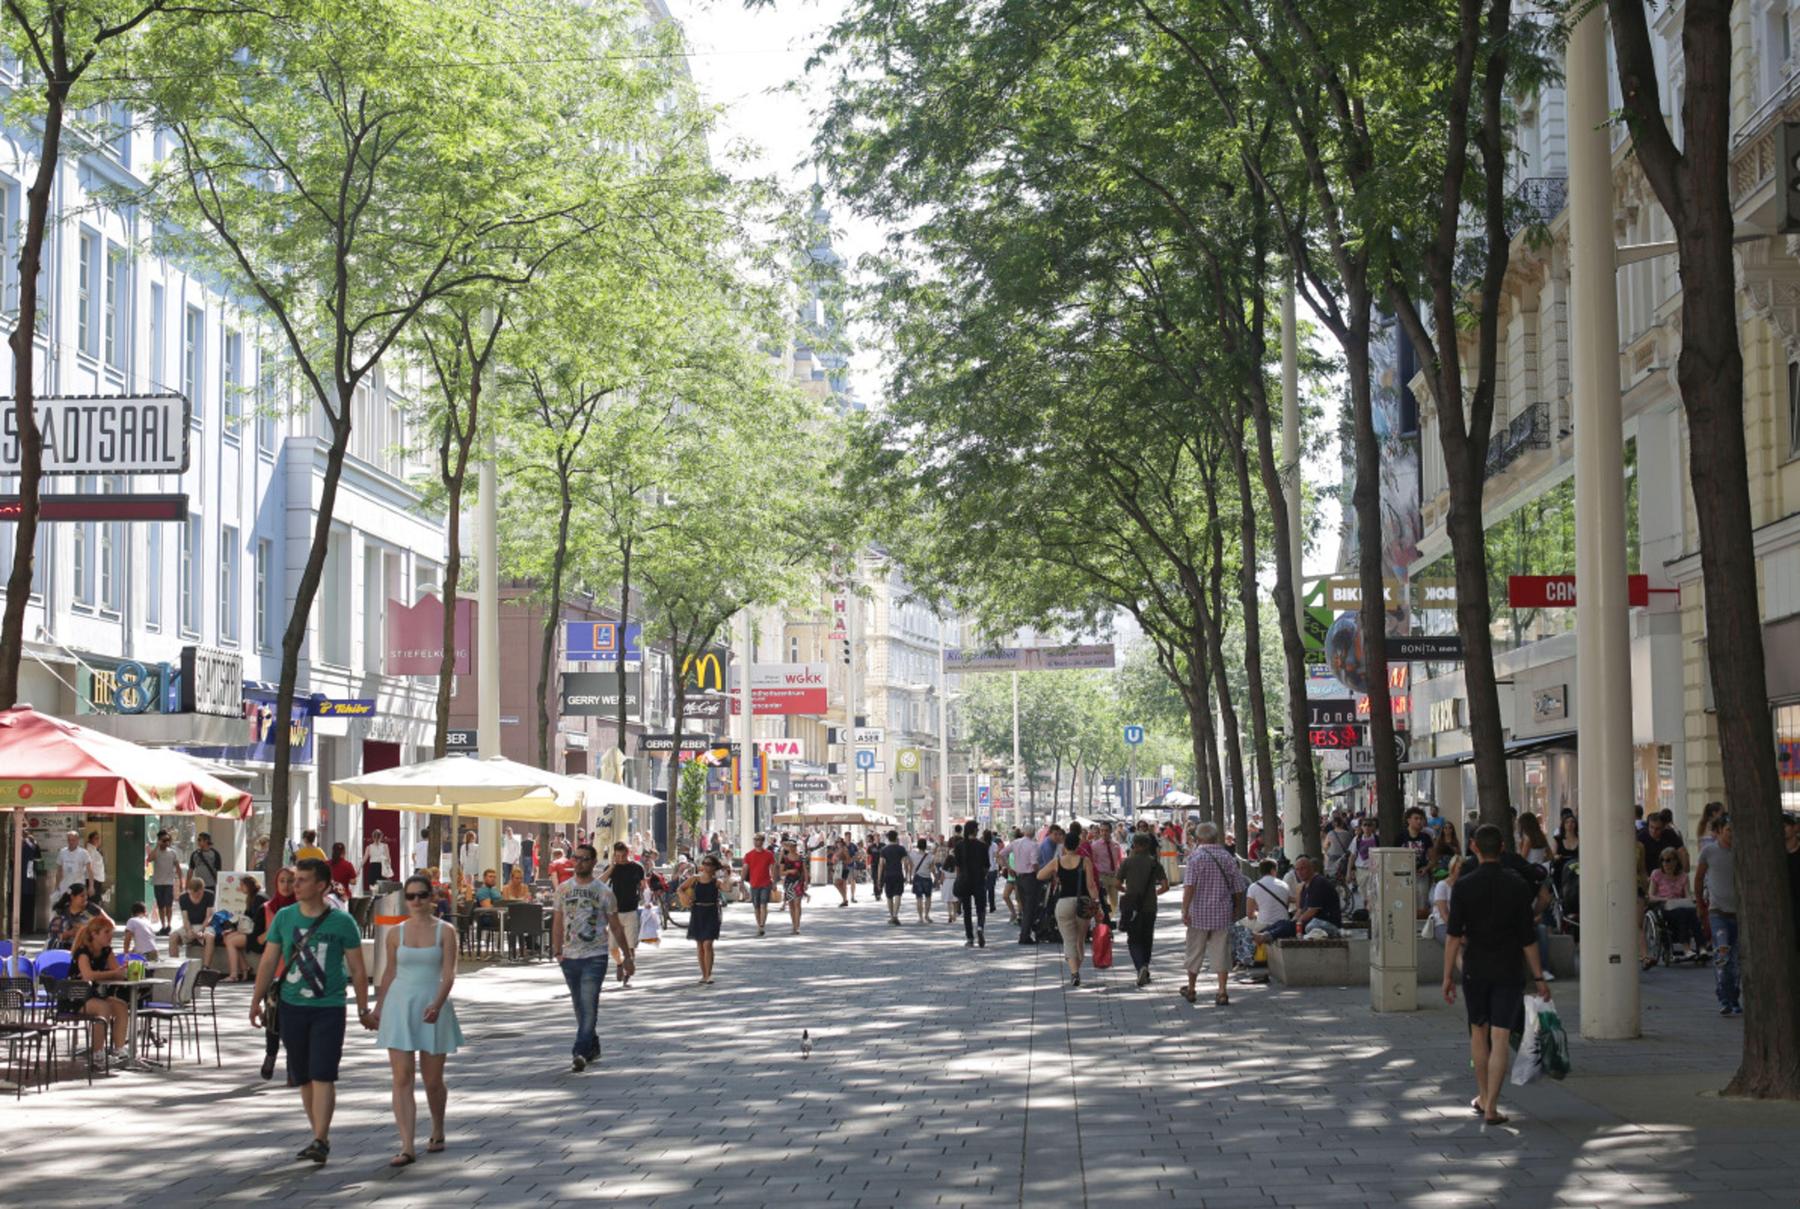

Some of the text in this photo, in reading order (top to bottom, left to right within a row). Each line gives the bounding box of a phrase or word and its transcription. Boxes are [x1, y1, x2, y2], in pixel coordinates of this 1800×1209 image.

[4, 405, 176, 463] SADTSAAL
[389, 648, 467, 658] STIEFELKIG
[568, 695, 636, 705] GERRY WEER
[446, 733, 467, 745] BER
